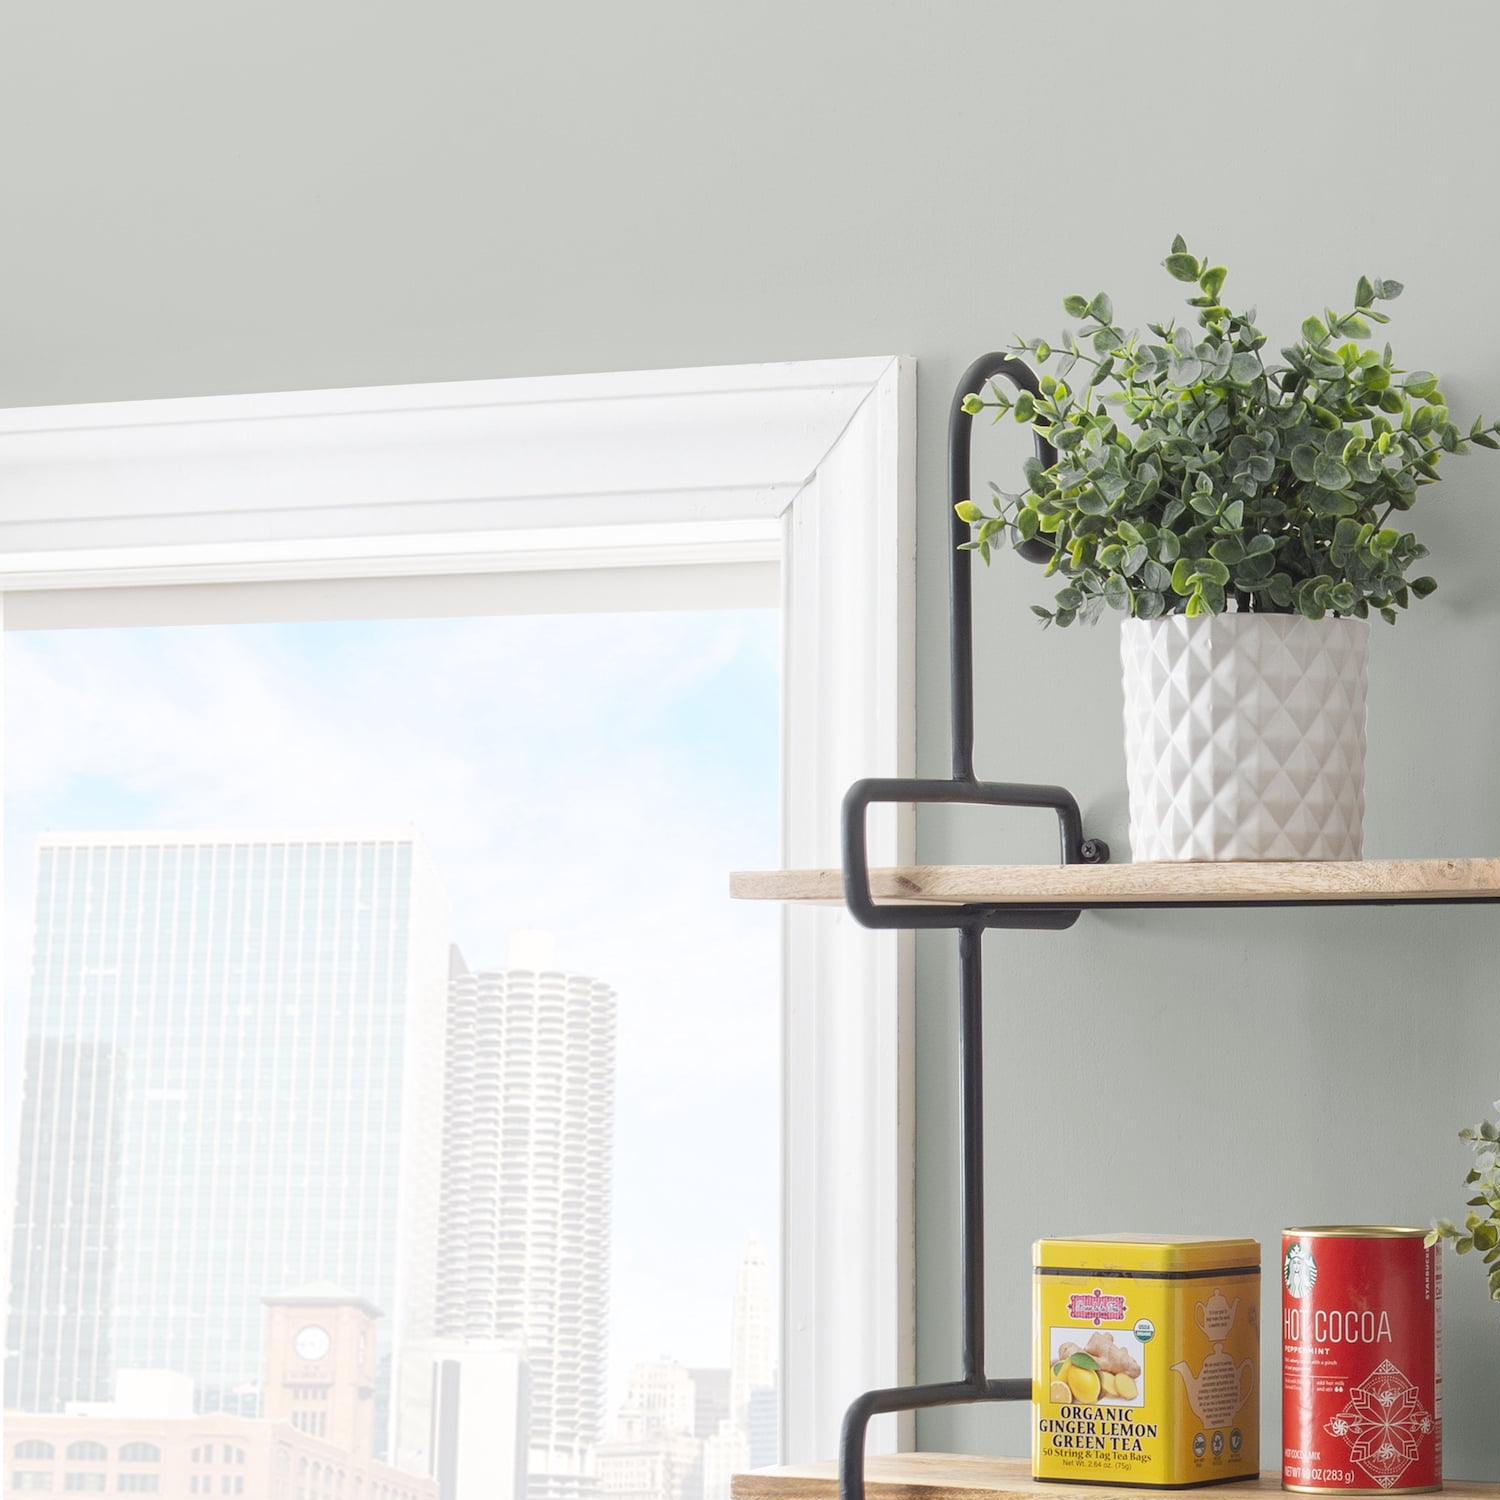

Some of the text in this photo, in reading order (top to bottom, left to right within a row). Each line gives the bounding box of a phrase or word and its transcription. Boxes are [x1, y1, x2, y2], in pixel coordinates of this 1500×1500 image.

[1284, 1308, 1308, 1341] HOT
[1315, 1310, 1393, 1343] COCOA
[1061, 1406, 1134, 1422] ORGANIC
[1039, 1419, 1157, 1438] GINGER LEMON
[1053, 1434, 1142, 1451] GREEN TEA
[1043, 1448, 1152, 1463] 50 String & Tag Tea Bags
[1311, 1469, 1322, 1480] OZ
[1323, 1469, 1343, 1482] (283
[1345, 1470, 1355, 1484] g)
